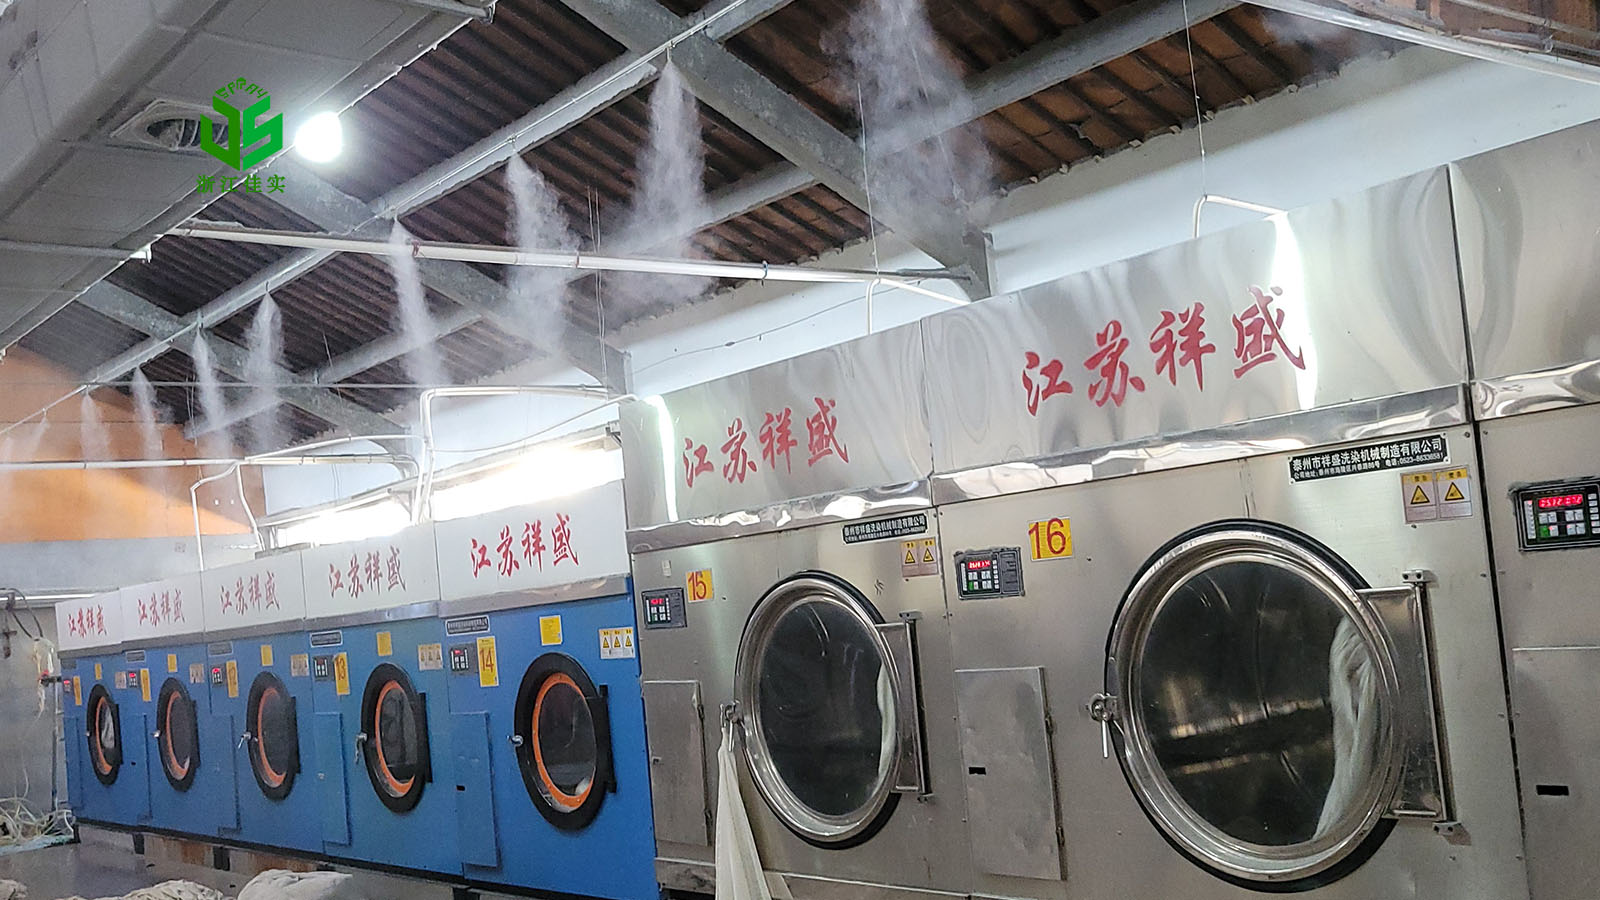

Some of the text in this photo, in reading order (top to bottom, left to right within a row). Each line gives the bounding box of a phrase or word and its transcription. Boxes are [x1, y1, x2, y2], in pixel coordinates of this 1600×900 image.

[1021, 287, 1306, 417] 江苏祥盛
[681, 395, 849, 489] 江苏祥盛
[1292, 437, 1442, 472] 泰州市祥盛洗染机械制造有限公司
[470, 511, 579, 579] 江苏祥盛
[1028, 517, 1067, 560] 16
[220, 570, 280, 616] 江苏祥盛
[328, 545, 407, 599] 江苏祥盛
[687, 571, 707, 601] 15
[137, 588, 186, 628] 江苏祥盛
[335, 657, 346, 681] 13
[479, 648, 495, 673] 14
